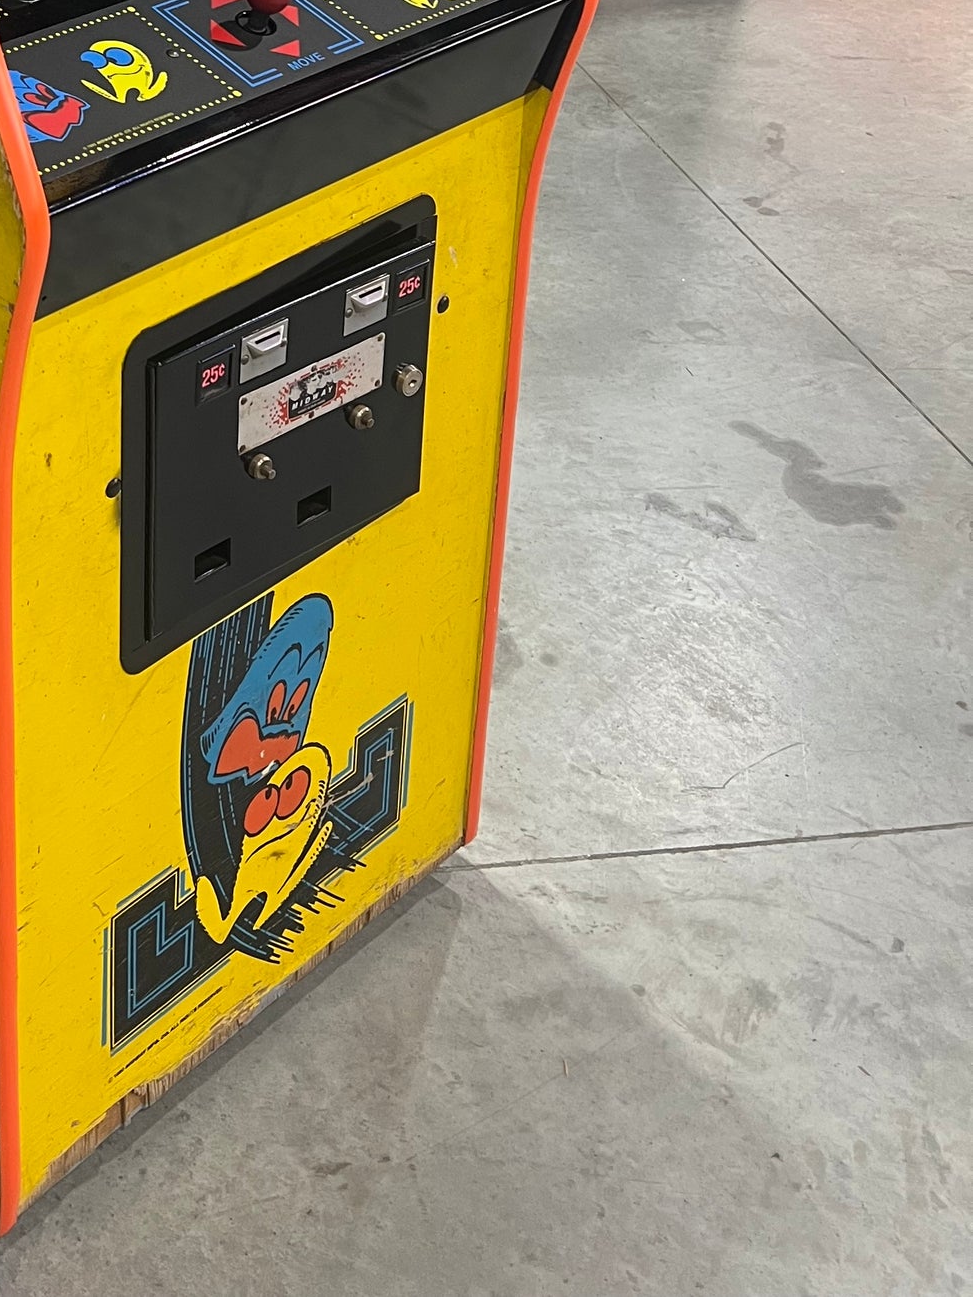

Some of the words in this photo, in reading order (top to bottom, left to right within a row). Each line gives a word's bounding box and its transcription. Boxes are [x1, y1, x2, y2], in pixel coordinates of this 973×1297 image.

[286, 51, 326, 72] MOVE
[398, 275, 421, 298] 25¢
[201, 363, 226, 388] 25¢
[291, 385, 333, 411] MIDWAY
